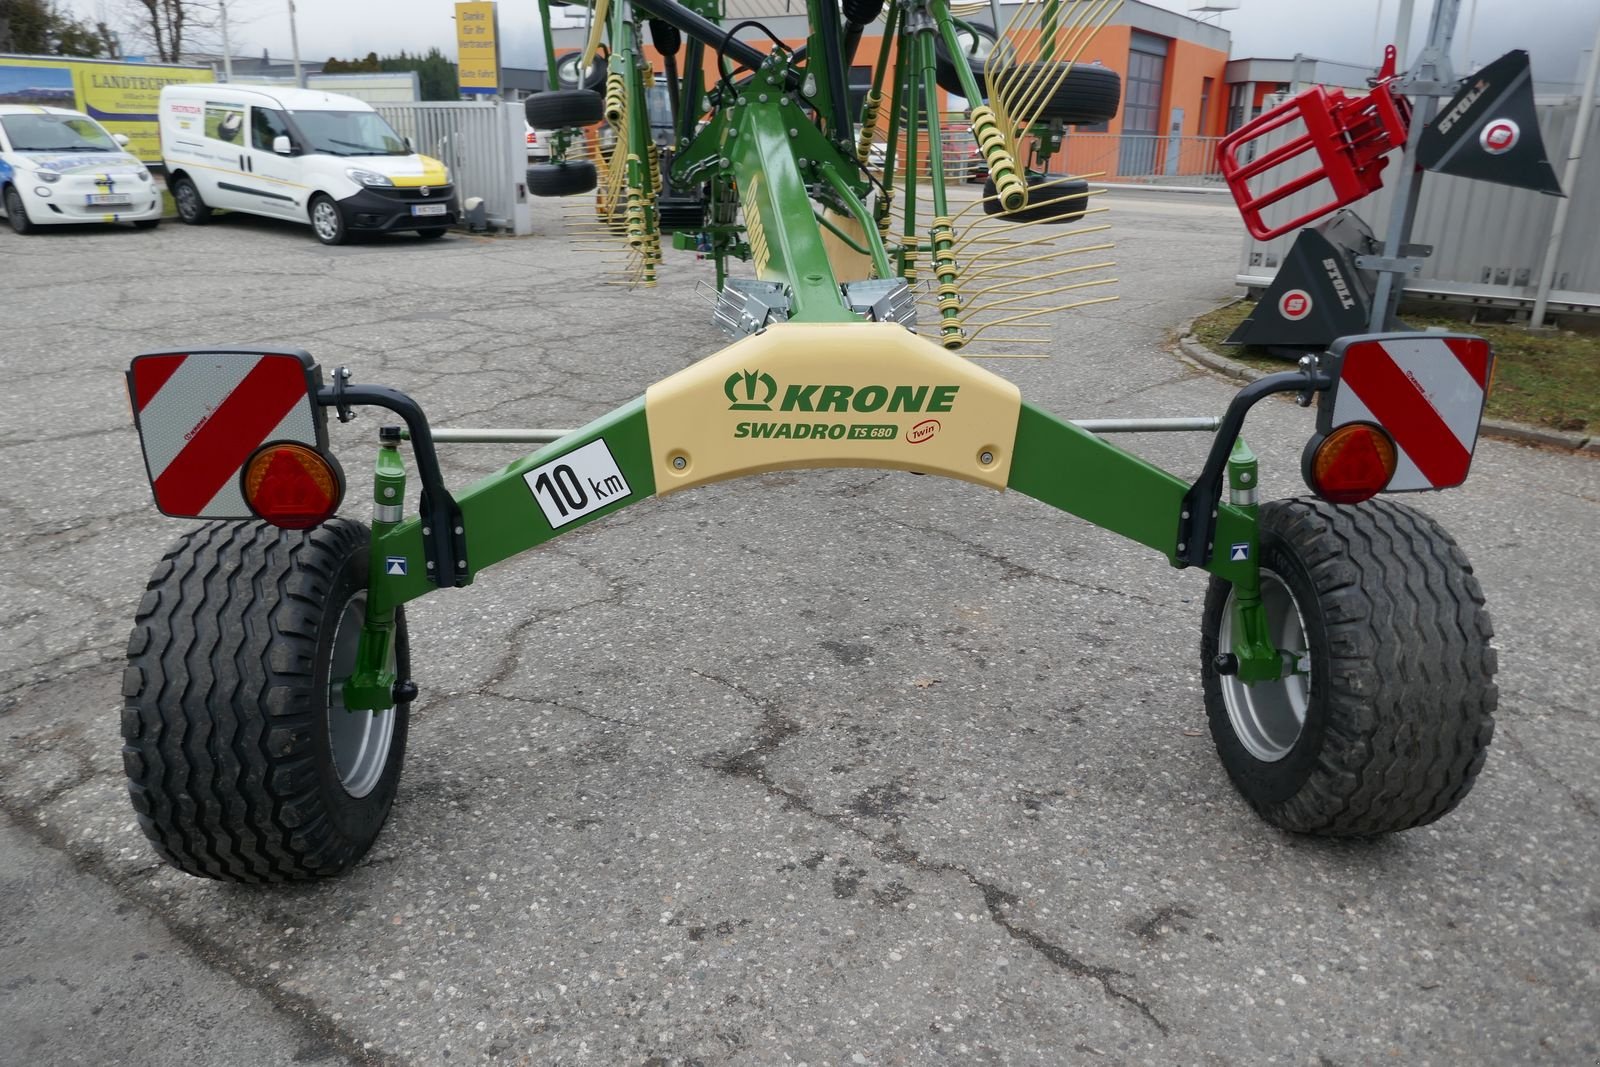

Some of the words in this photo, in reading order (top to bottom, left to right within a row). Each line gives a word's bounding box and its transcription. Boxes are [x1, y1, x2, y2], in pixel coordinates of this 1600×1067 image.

[1438, 80, 1490, 135] STOLL
[1322, 258, 1355, 310] STOLL
[779, 384, 960, 413] KRONE
[734, 422, 847, 440] SWADRO
[853, 427, 867, 437] TS
[870, 427, 893, 438] 680
[912, 424, 936, 440] Twin
[535, 464, 588, 517] 10
[587, 474, 624, 501] km
